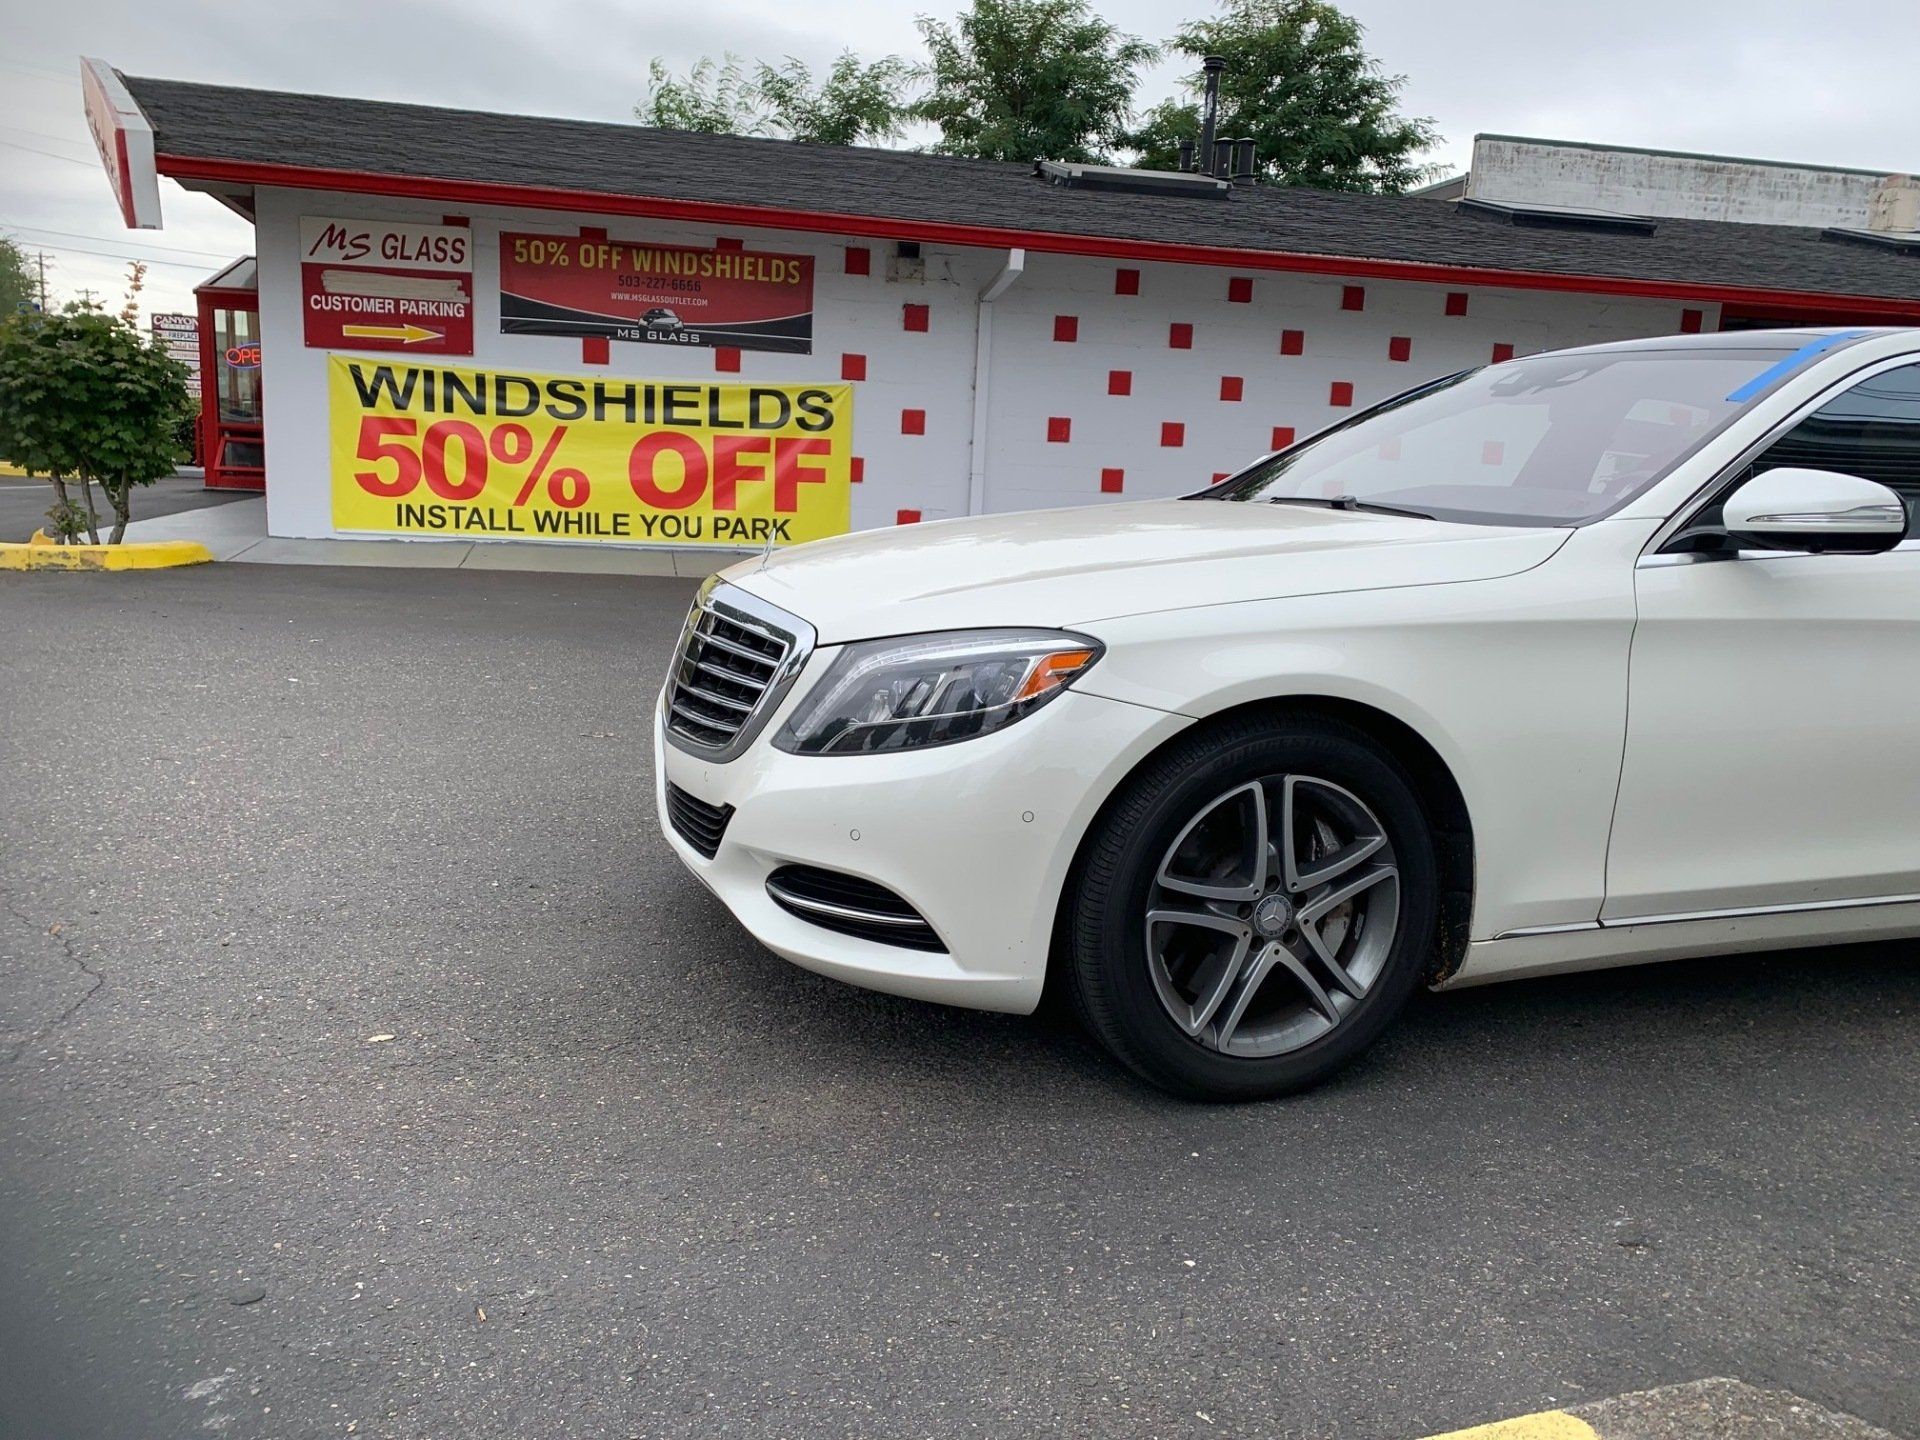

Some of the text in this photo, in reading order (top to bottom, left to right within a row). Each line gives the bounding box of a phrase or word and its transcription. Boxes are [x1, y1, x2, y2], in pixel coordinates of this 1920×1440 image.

[381, 233, 466, 264] GLASS
[514, 239, 801, 284] 50% OFF WINDSHIELDS
[618, 275, 701, 292] 503-227-6666
[310, 294, 465, 318] CUSTOMER PARKING
[611, 292, 708, 306] WWW.MSGLASSOUTLET.COM
[153, 315, 199, 327] CANYON
[617, 328, 700, 343] MS GLASS
[226, 348, 261, 364] OPE
[348, 363, 835, 432] WINDSHIELDS
[353, 415, 832, 513] 50% OFF
[396, 503, 792, 541] INSTALL WHILE YOU PARK
